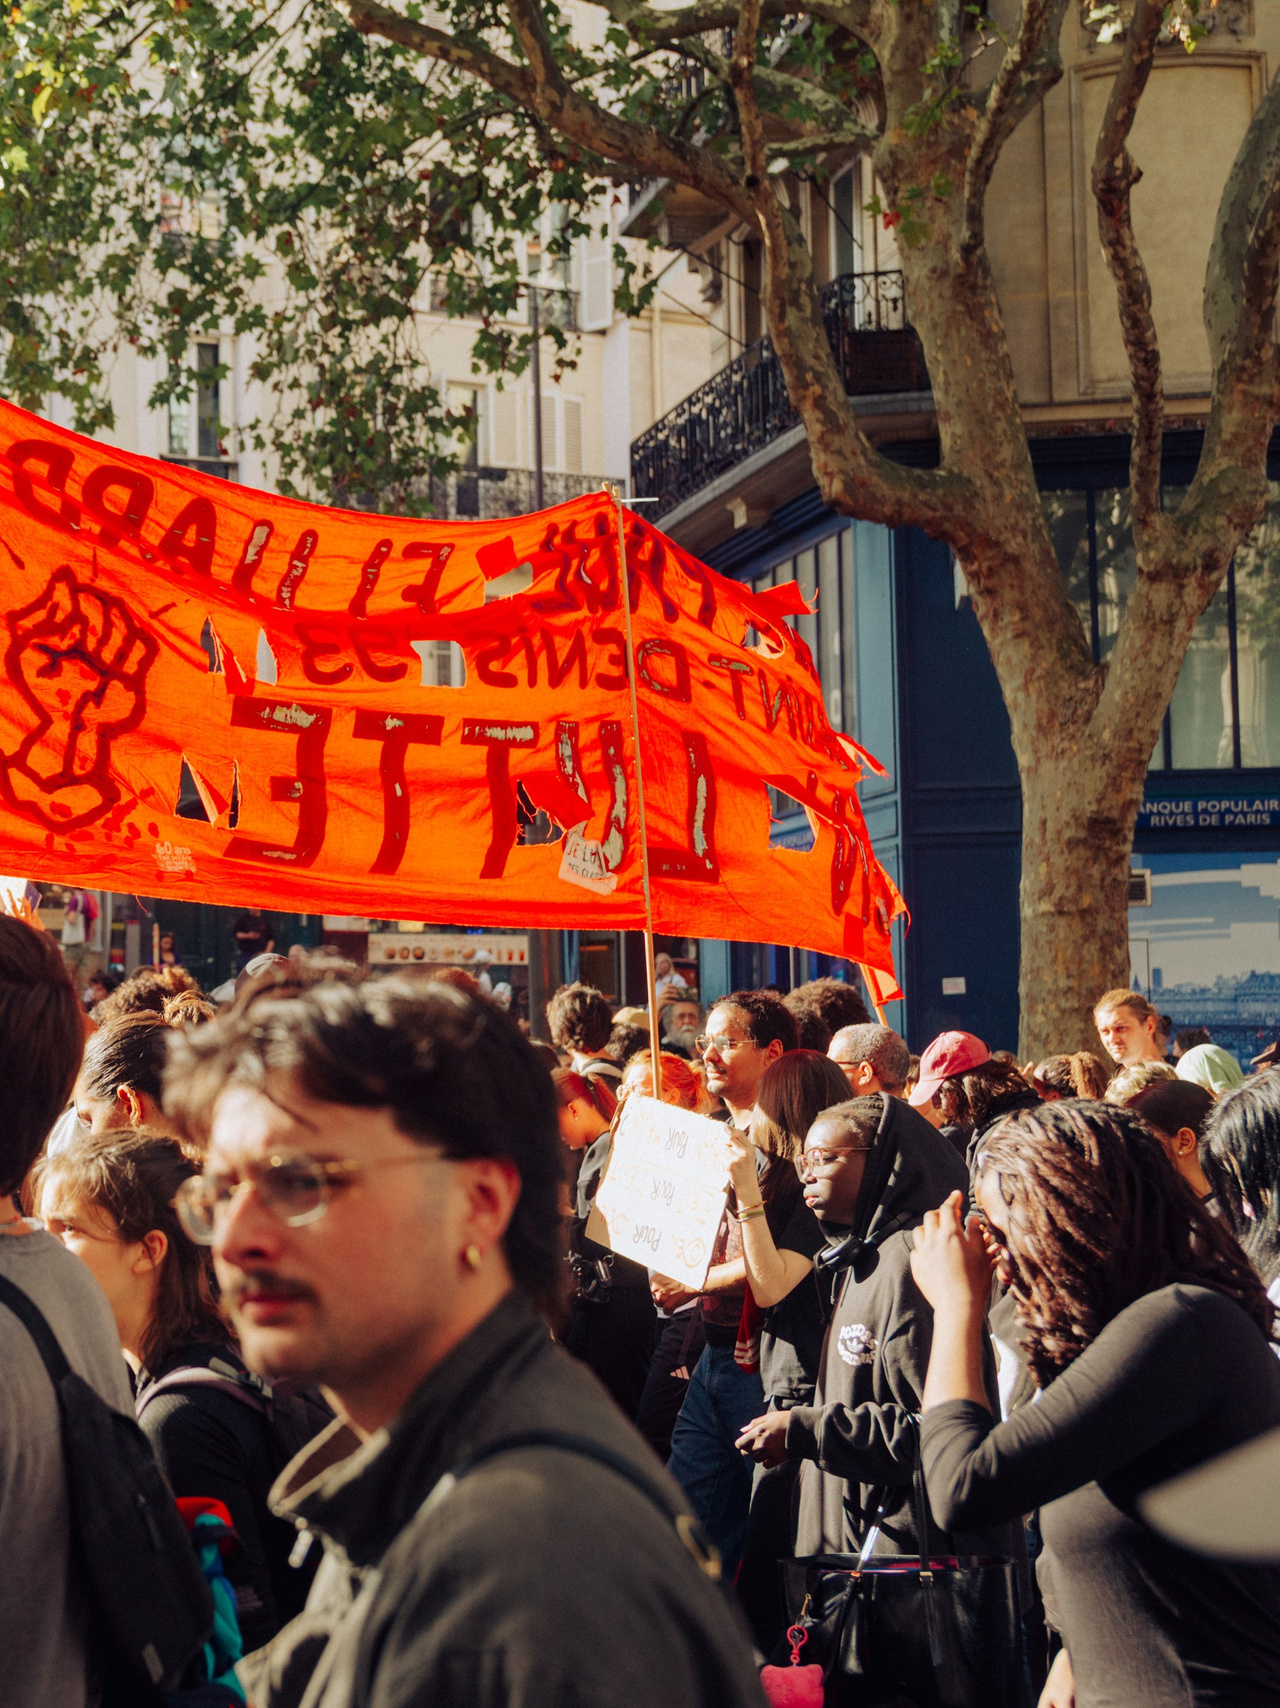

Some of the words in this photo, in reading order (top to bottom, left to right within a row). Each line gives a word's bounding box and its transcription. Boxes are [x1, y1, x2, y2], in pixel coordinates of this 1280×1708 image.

[1137, 801, 1194, 814] ANQUE
[1197, 799, 1280, 812] POPULAIR
[1150, 813, 1195, 827] RIVES
[1198, 814, 1221, 827] DE
[1224, 812, 1271, 826] PARIS
[156, 841, 172, 855] 60
[567, 841, 580, 859] JE
[665, 1126, 690, 1159] POUR
[650, 1175, 676, 1207] POUR
[632, 1224, 662, 1252] POUR
